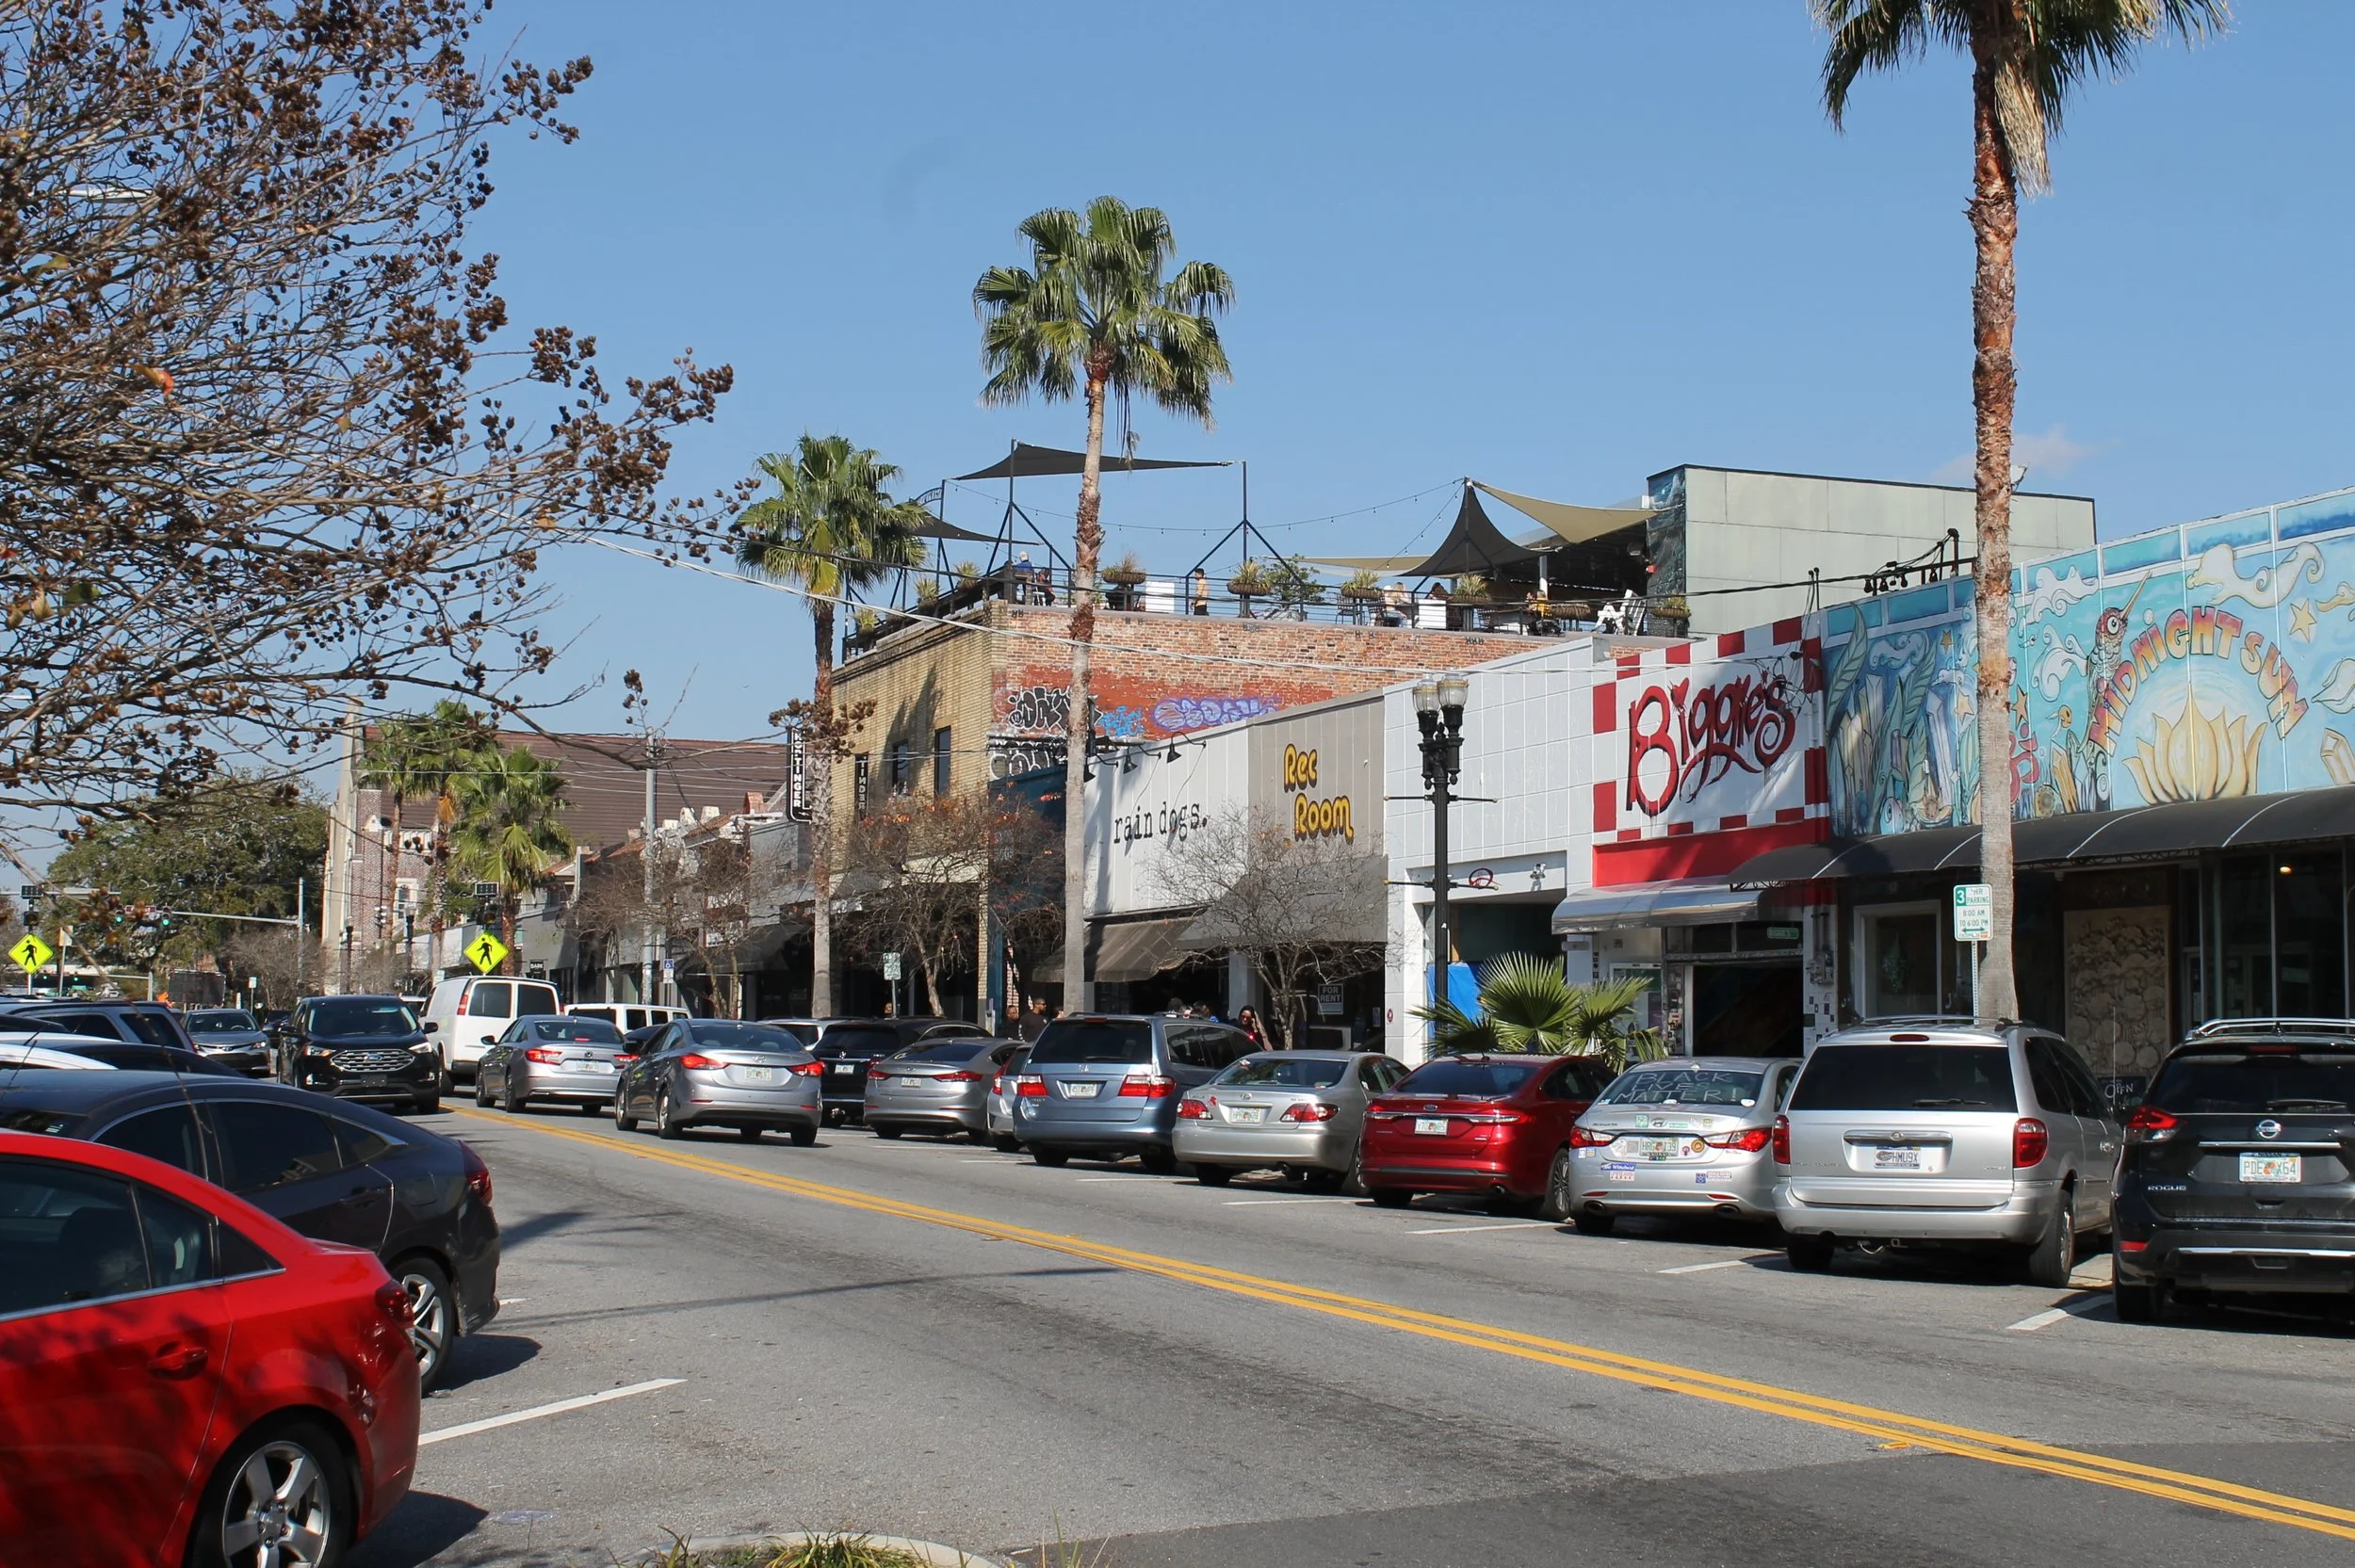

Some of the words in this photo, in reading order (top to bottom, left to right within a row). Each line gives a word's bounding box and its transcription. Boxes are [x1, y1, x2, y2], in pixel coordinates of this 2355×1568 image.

[2239, 630, 2310, 741] SUN
[1284, 743, 1317, 793] Rec
[1113, 805, 1153, 844] rain
[1294, 792, 1354, 846] Room
[1957, 889, 1965, 904] 3
[1966, 896, 1990, 904] PARKING
[1323, 986, 1339, 994] FOR
[1635, 1071, 1734, 1084] BLACK
[1631, 1082, 1711, 1092] LIVES
